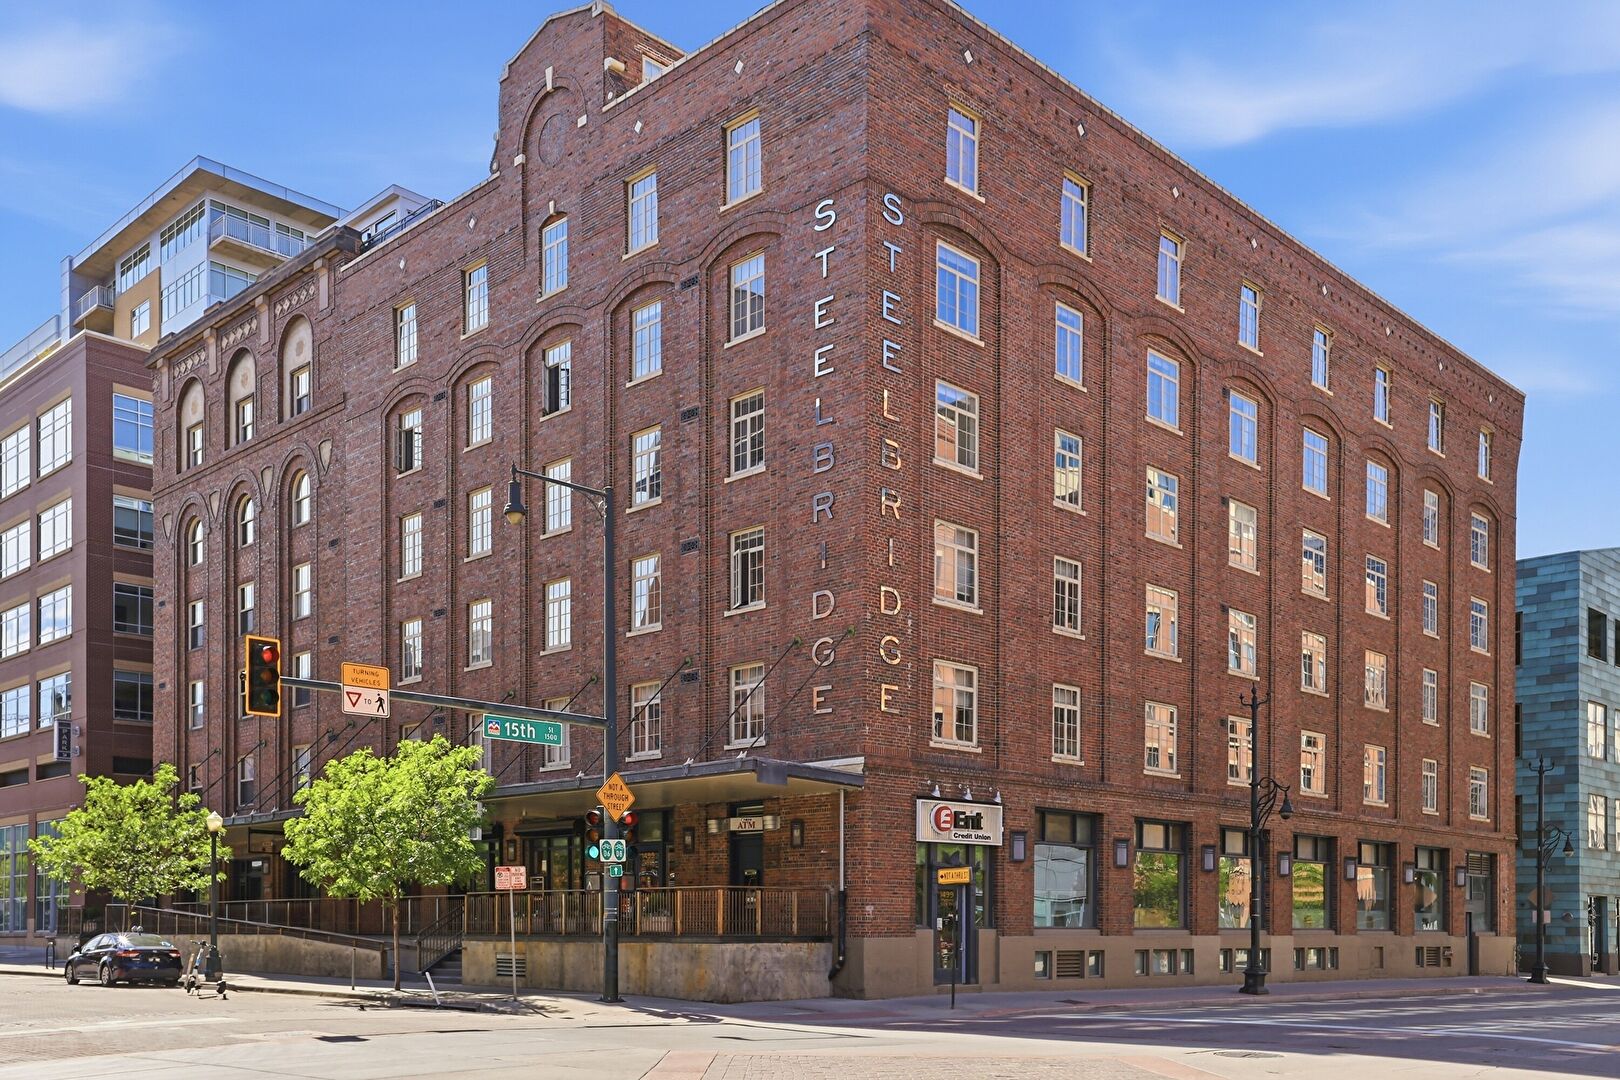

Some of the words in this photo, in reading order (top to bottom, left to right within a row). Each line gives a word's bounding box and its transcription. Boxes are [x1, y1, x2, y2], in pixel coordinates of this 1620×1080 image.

[812, 199, 837, 714] STEELBRIDGE
[880, 193, 904, 714] STEELBRIDGE
[353, 668, 380, 677] TURNING
[351, 677, 382, 687] VEHICLES
[504, 721, 536, 739] 15th
[544, 733, 558, 741] 1500
[608, 783, 618, 791] NOT
[603, 792, 629, 802] THROUGH
[608, 802, 625, 811] STREET
[737, 821, 756, 829] ATM
[974, 833, 992, 841] Union
